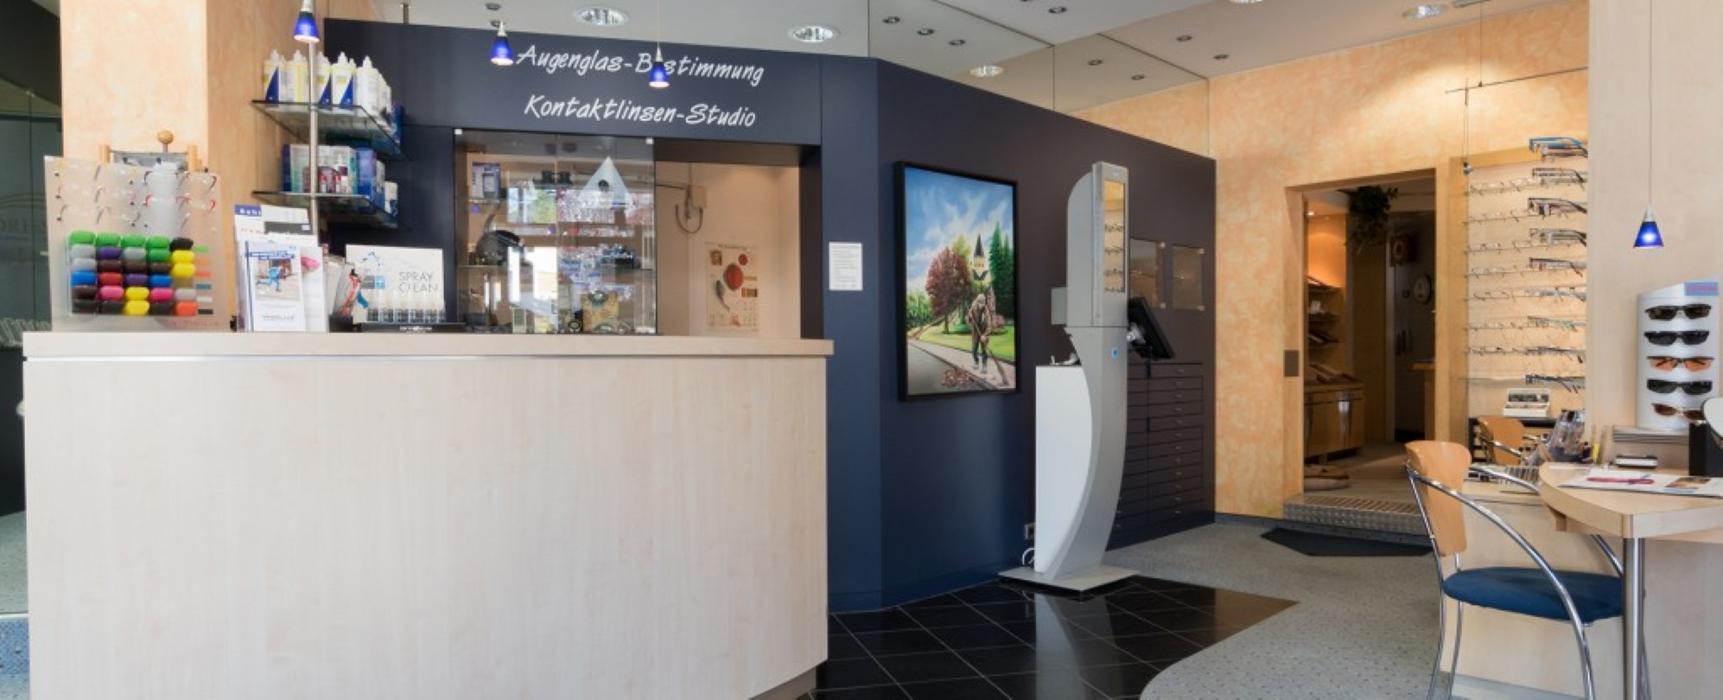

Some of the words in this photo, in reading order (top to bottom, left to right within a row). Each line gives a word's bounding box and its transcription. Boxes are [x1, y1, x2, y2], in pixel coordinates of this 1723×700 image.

[516, 44, 765, 87] Augenglas-Bstimmung
[524, 94, 756, 127] Kontaktlinsen-Studio
[399, 271, 434, 282] SPRAY
[399, 281, 440, 293] CLEAN
